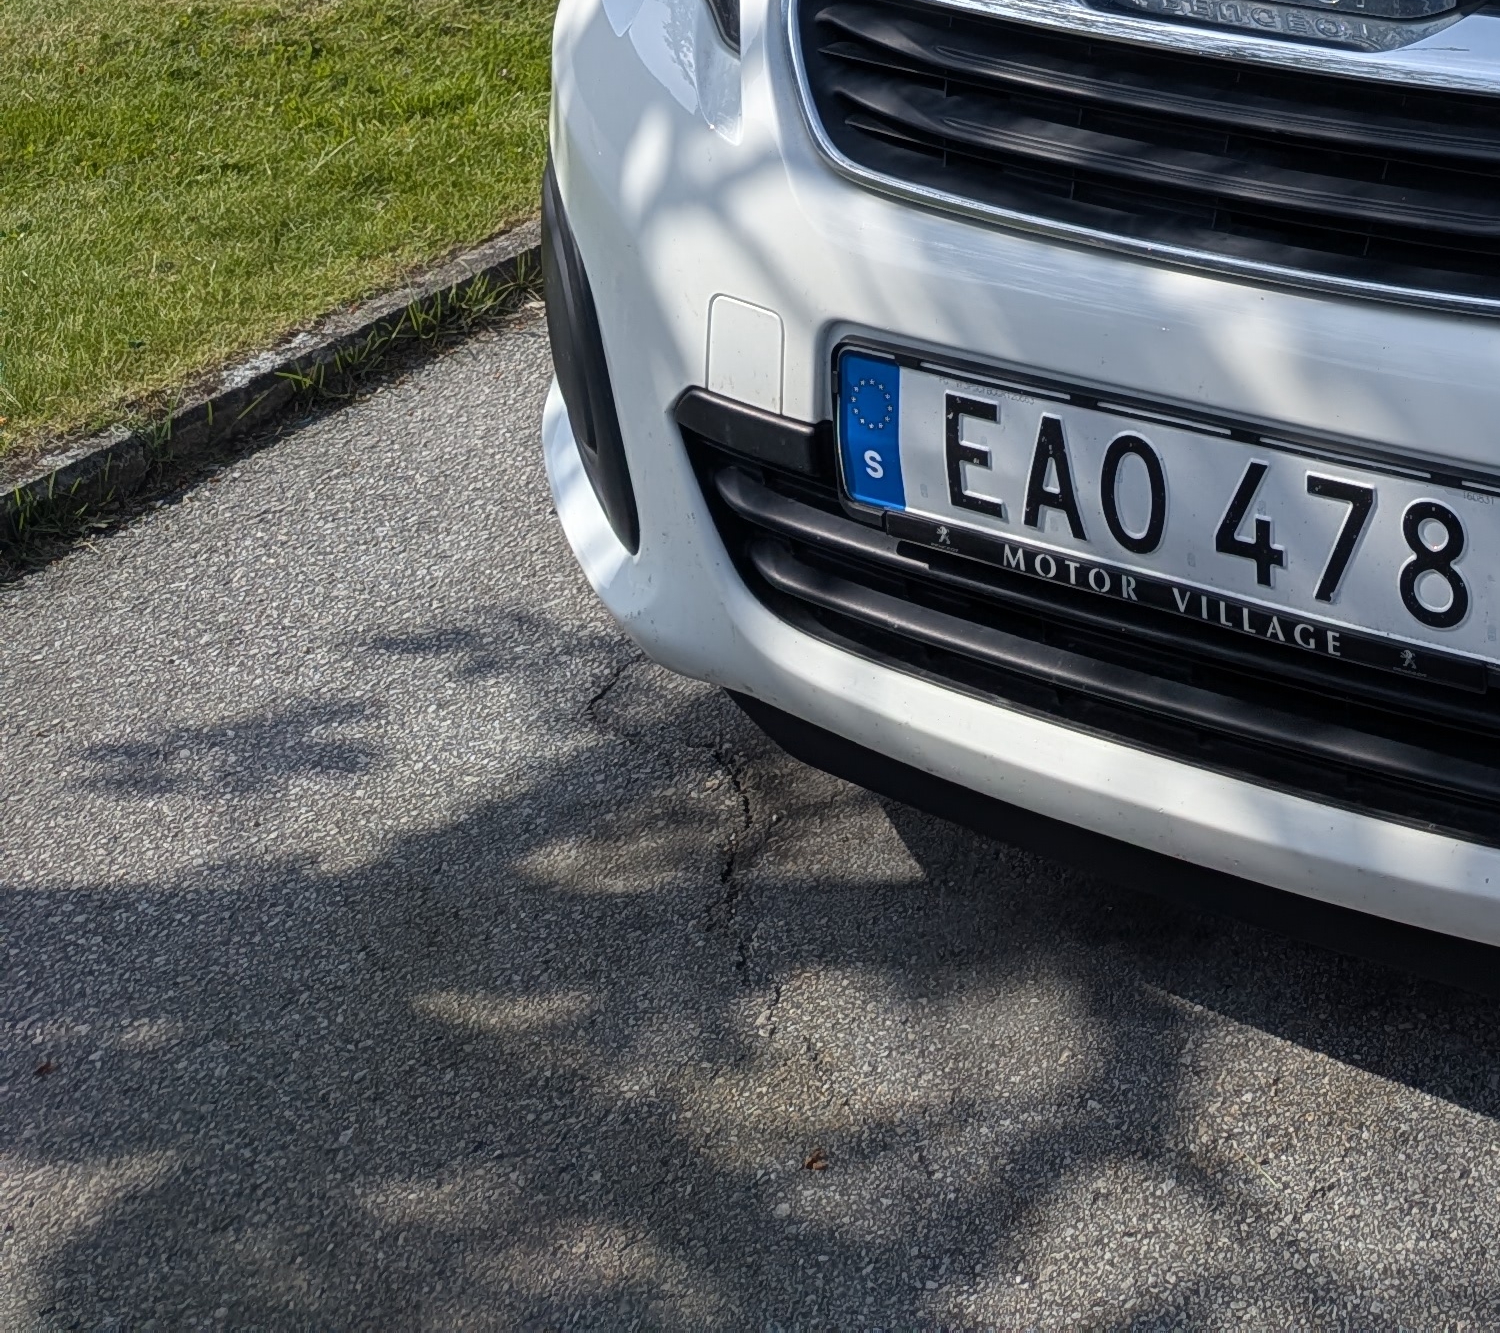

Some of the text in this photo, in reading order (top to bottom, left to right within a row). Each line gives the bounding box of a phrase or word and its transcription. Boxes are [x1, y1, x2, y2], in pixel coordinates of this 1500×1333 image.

[864, 450, 884, 479] S
[944, 391, 1470, 628] EAO 478
[1003, 543, 1341, 656] MOTOR VILLAGE
